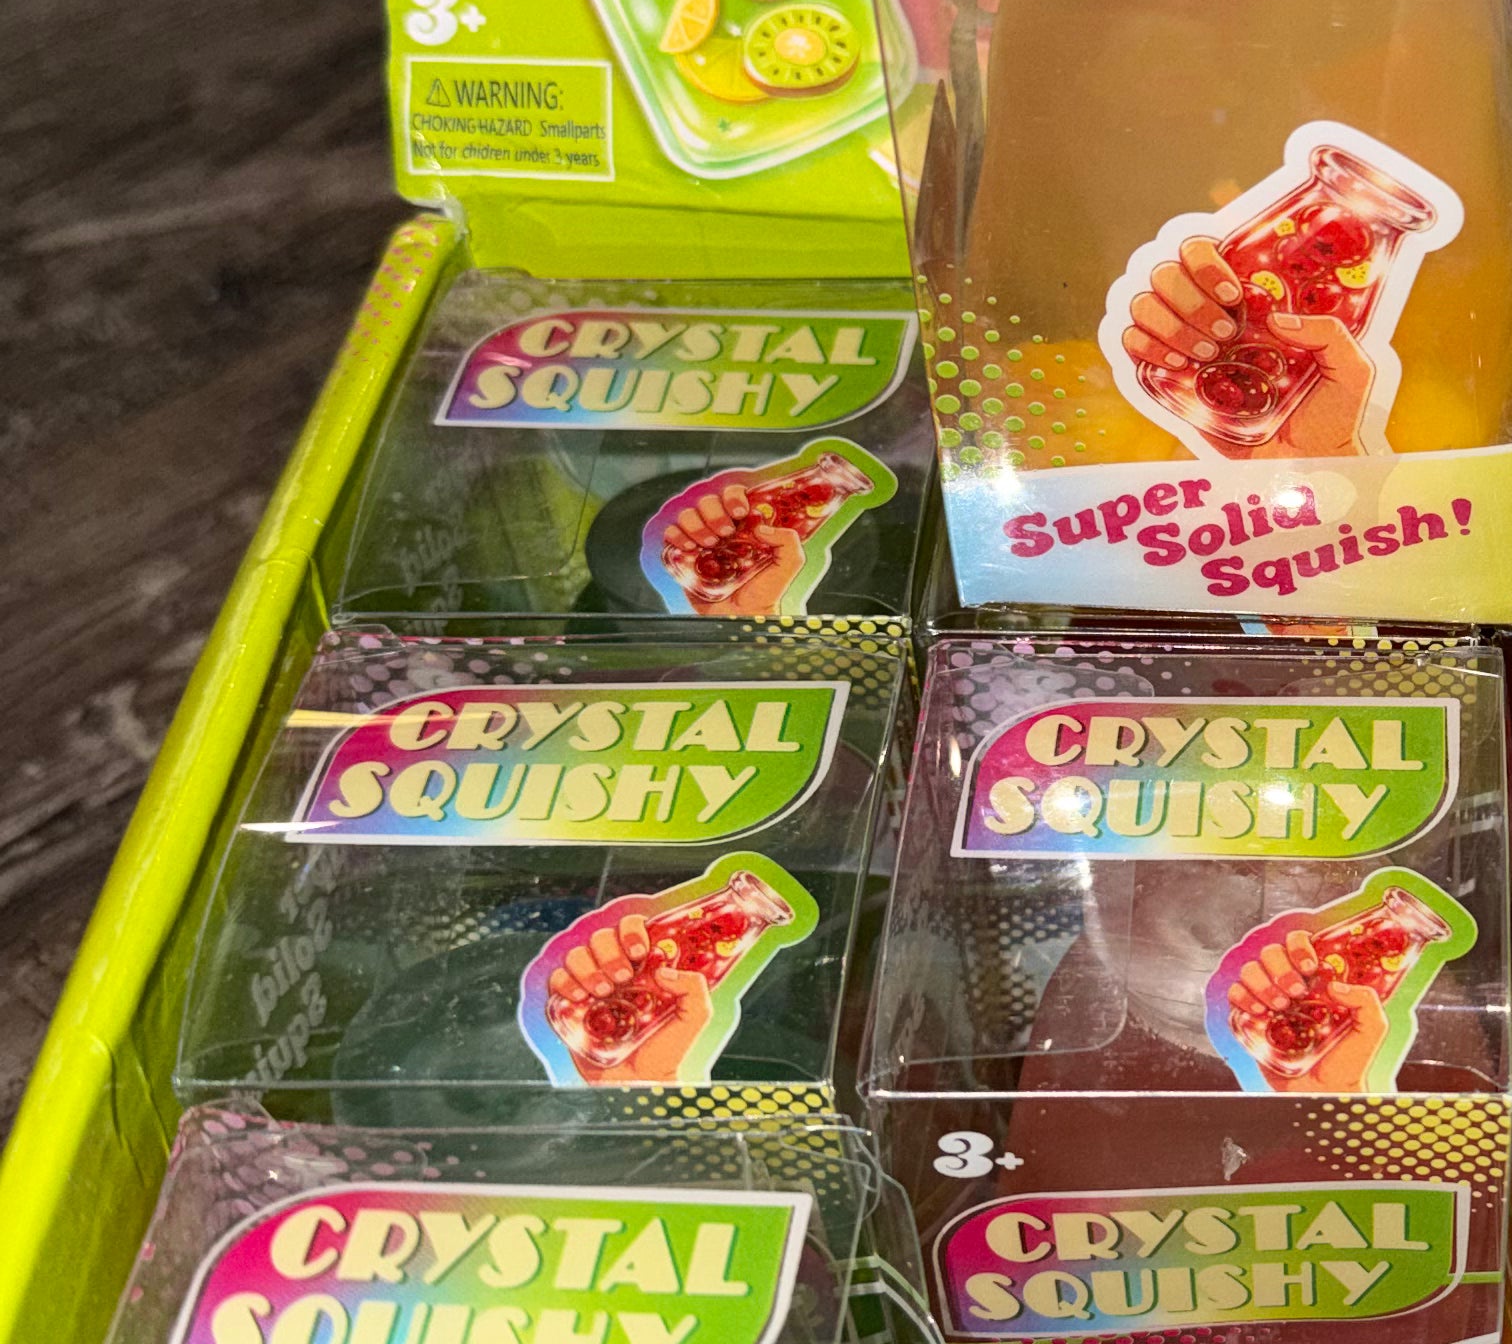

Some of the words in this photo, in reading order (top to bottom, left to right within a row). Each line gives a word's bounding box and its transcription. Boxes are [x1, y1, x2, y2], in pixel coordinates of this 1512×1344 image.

[454, 79, 565, 111] WARNING:
[518, 318, 878, 367] CRYSTAL
[467, 365, 839, 418] SQUISHY
[1003, 478, 1212, 558] Super
[1137, 485, 1321, 568] Solid
[1200, 498, 1473, 597] Squish!
[389, 700, 801, 754] CRYSTAL
[1025, 714, 1427, 771] CRYSTAL
[329, 759, 759, 823] SQUISHY
[983, 775, 1389, 841] SQUISHY
[933, 1131, 1025, 1178] 3+
[268, 1204, 752, 1298] CRYSTAL
[985, 1202, 1431, 1264] CRYSTAL
[964, 1259, 1394, 1323] SQUISHY
